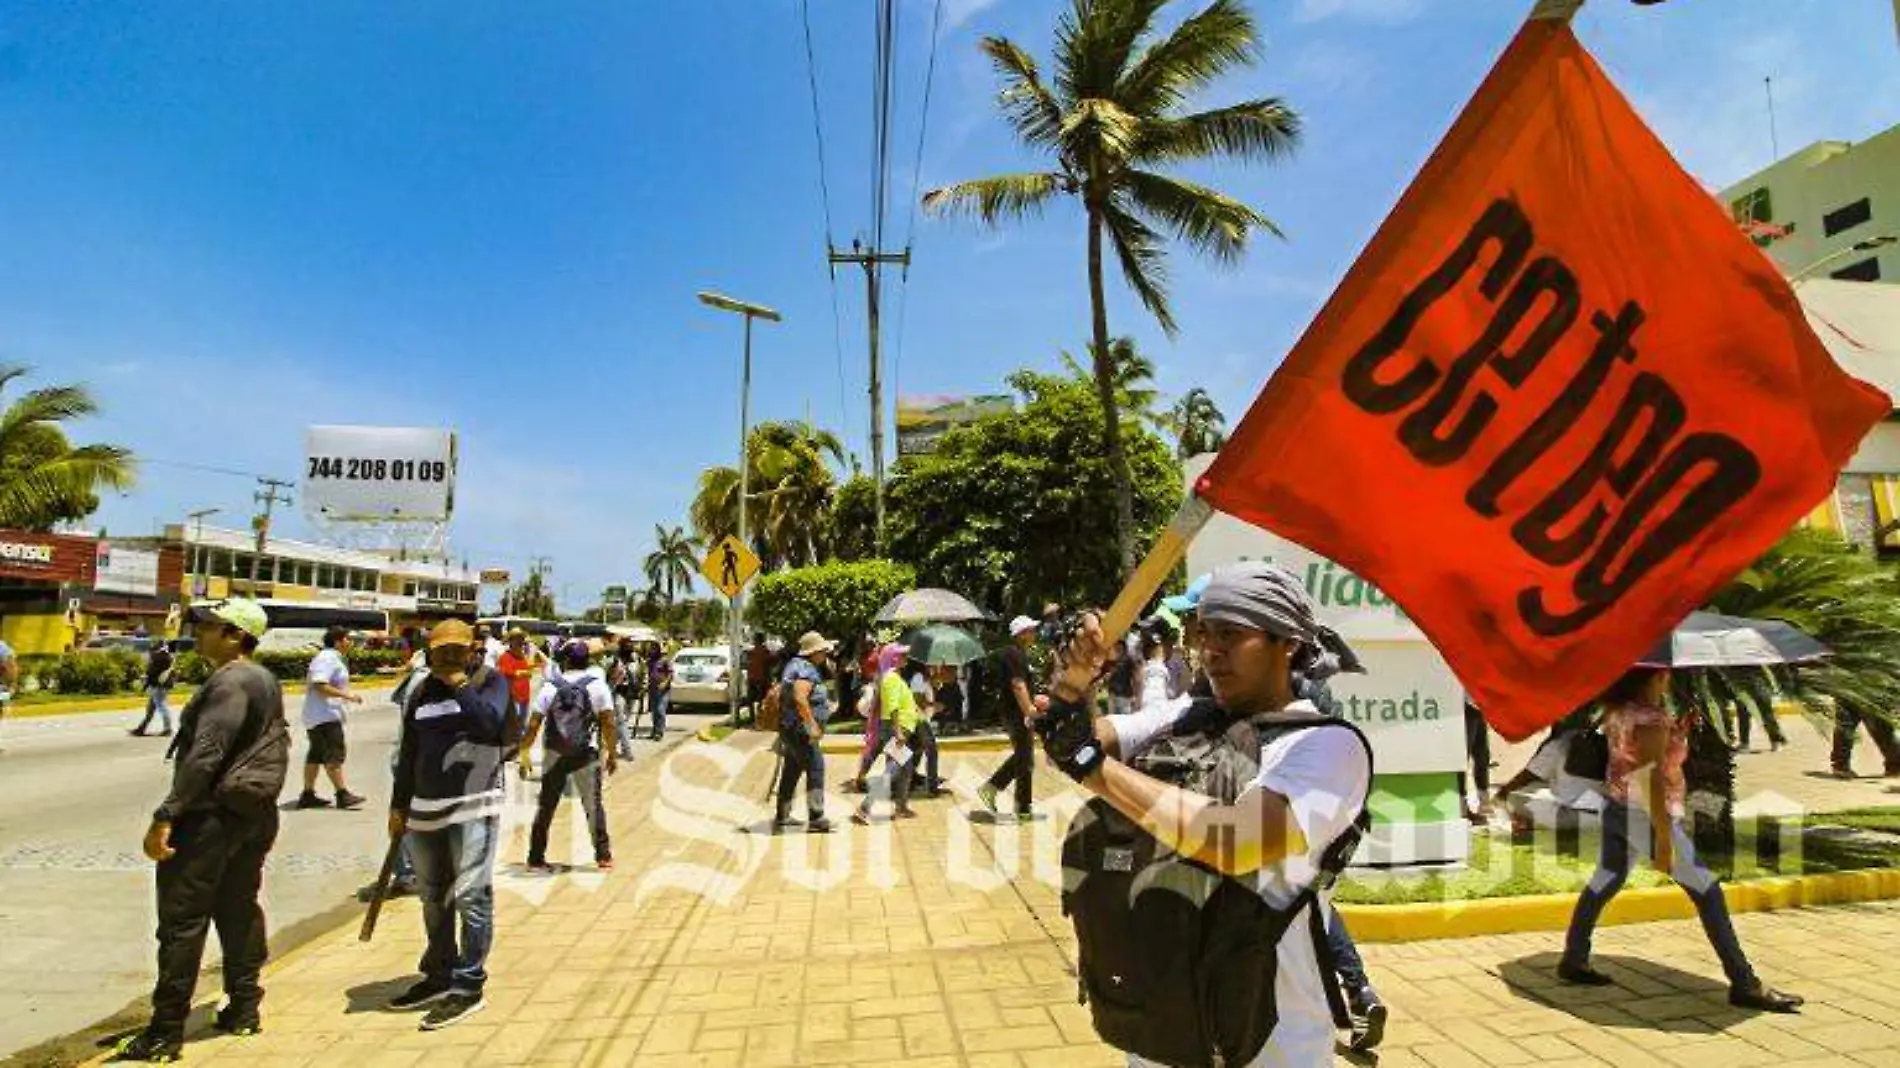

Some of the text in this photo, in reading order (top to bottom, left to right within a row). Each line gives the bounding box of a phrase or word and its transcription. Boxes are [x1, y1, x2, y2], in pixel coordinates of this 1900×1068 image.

[309, 457, 446, 482] 744 208 01 09
